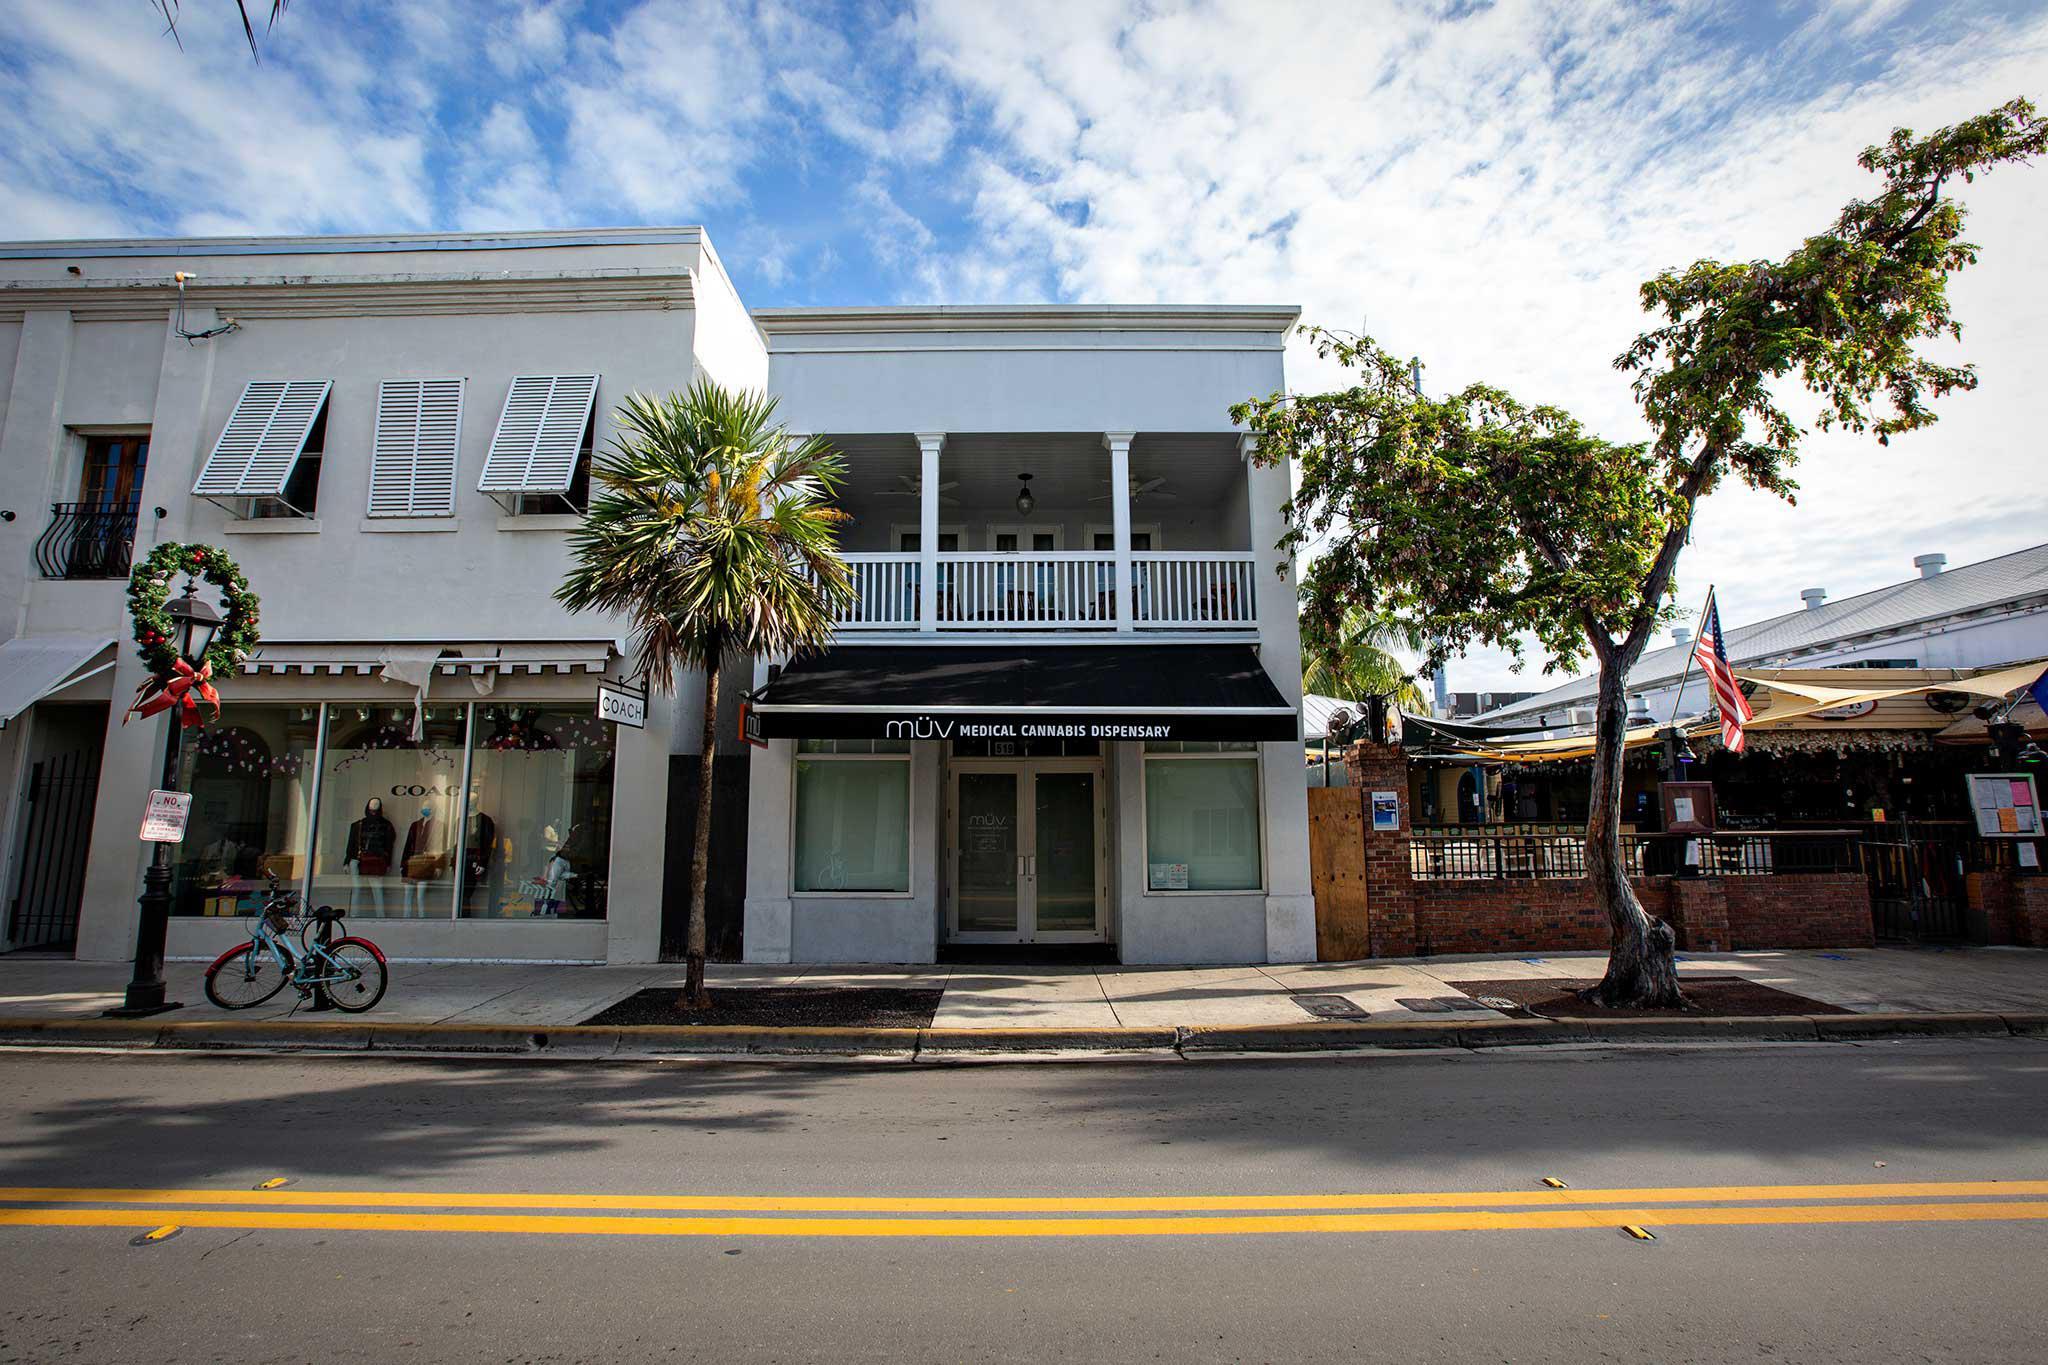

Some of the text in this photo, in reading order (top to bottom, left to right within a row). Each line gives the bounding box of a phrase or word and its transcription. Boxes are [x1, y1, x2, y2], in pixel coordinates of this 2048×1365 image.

[603, 696, 642, 720] COACH
[960, 724, 1017, 737] MEDICAL
[1021, 724, 1087, 737] CANNABIS
[1091, 725, 1171, 738] DISPENSARY
[997, 743, 1013, 753] 519
[163, 796, 177, 806] NO
